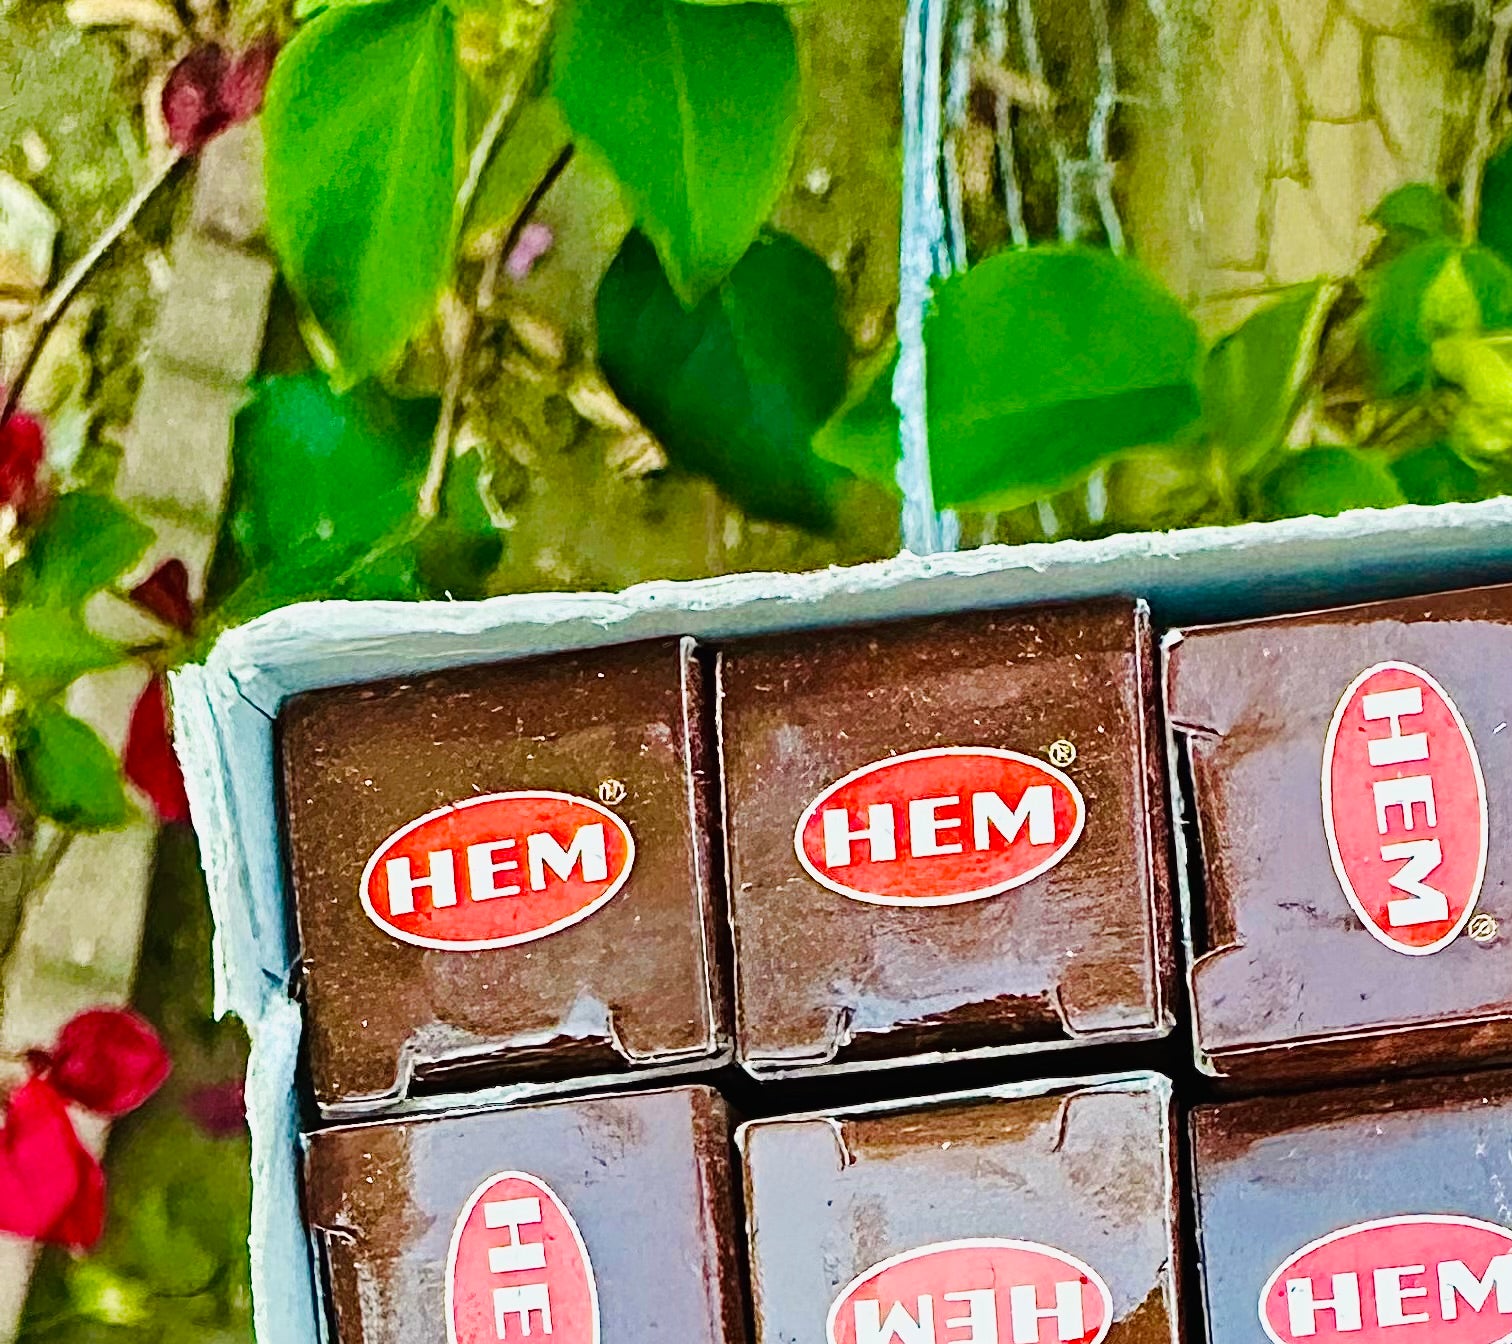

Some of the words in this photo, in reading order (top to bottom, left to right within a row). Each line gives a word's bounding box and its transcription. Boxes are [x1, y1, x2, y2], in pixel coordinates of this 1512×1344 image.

[824, 786, 1055, 866] HEM
[1363, 688, 1448, 926] HEM
[387, 824, 607, 914] HEM
